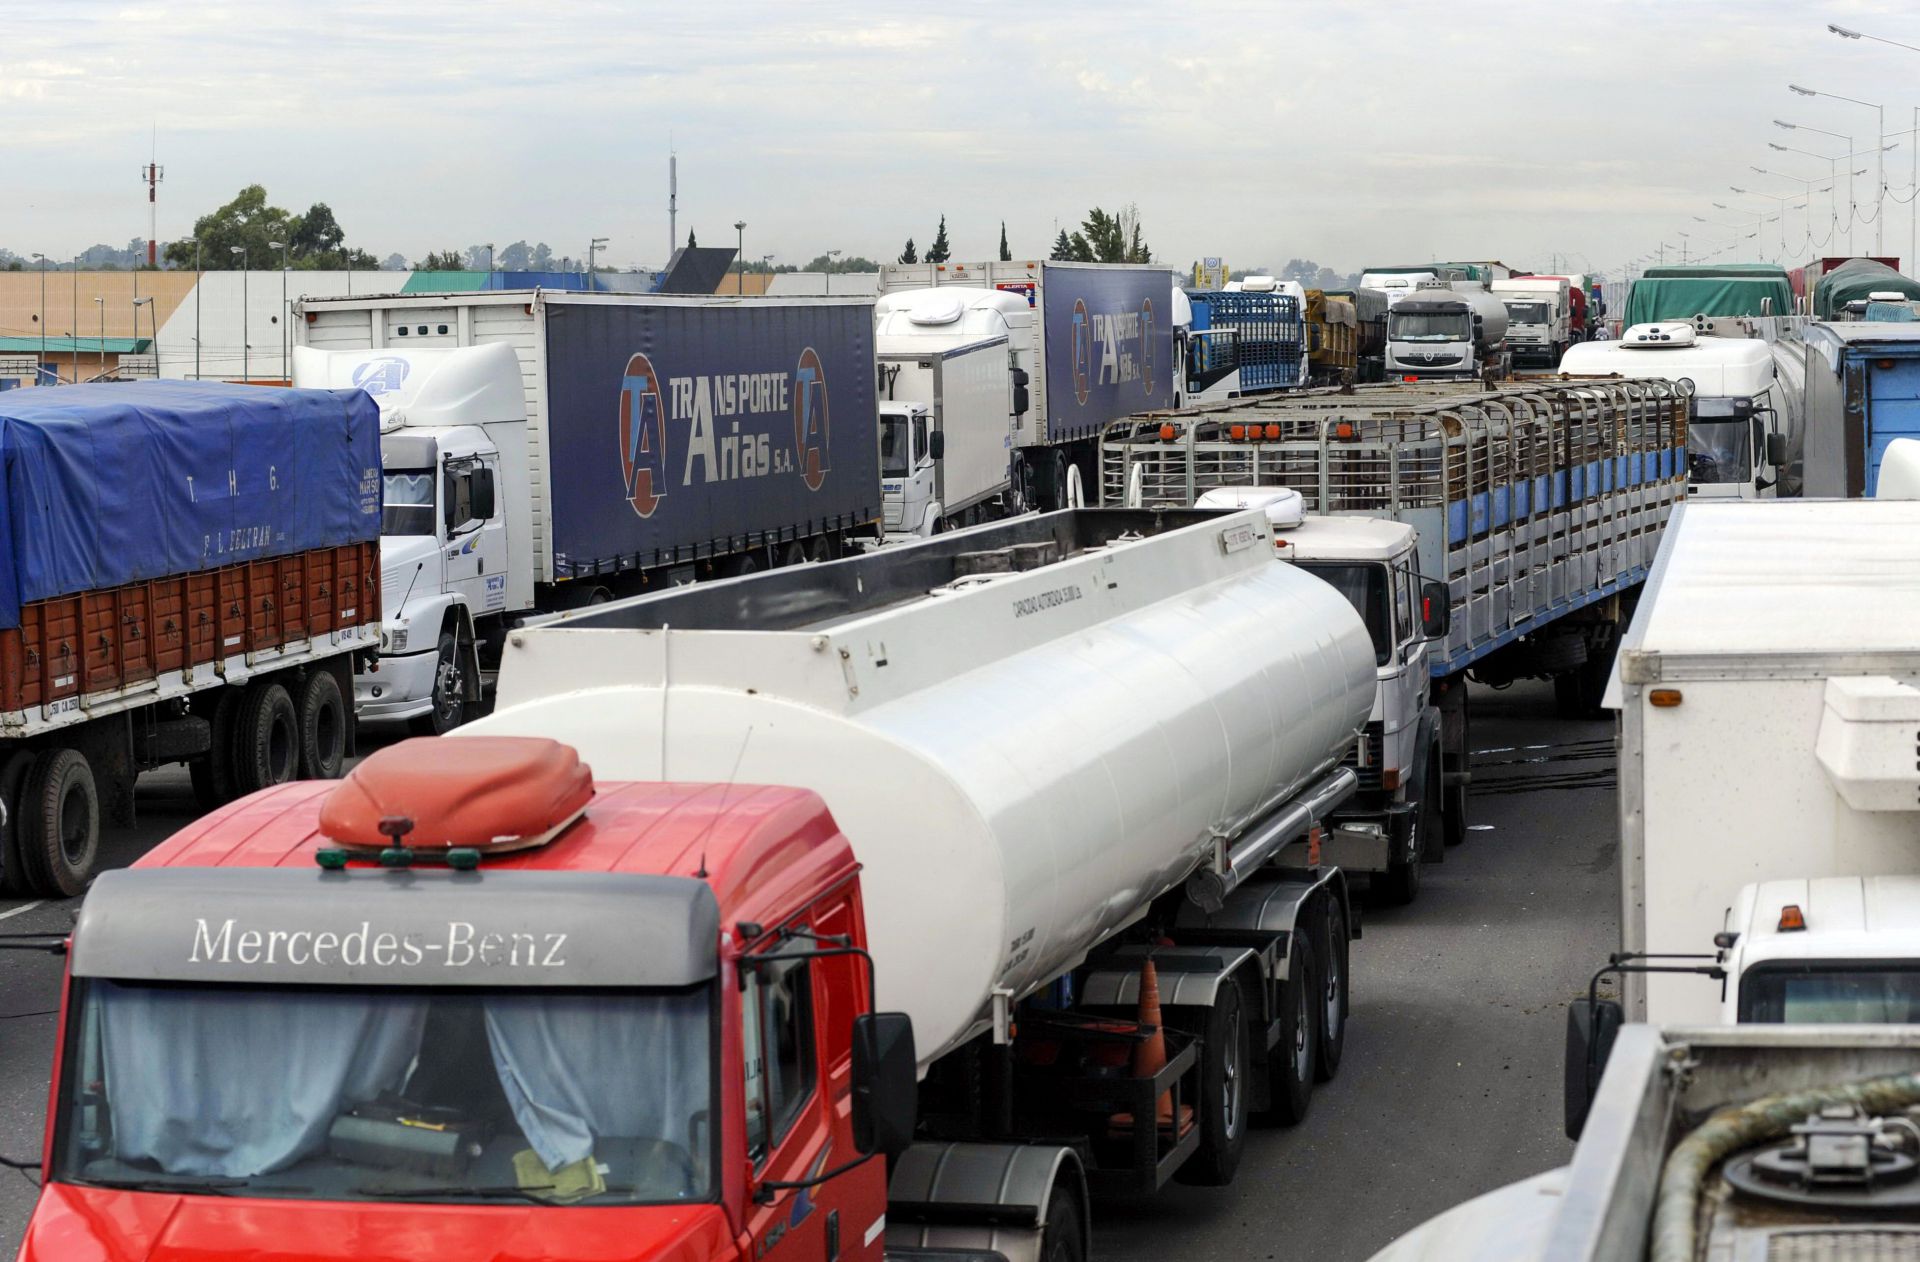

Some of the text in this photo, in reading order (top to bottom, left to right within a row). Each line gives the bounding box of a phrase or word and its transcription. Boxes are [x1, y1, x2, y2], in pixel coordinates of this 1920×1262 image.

[669, 372, 789, 420] TRANSPORTE
[682, 395, 794, 486] Arias S.A.
[187, 917, 569, 967] Mercedes-Benz
